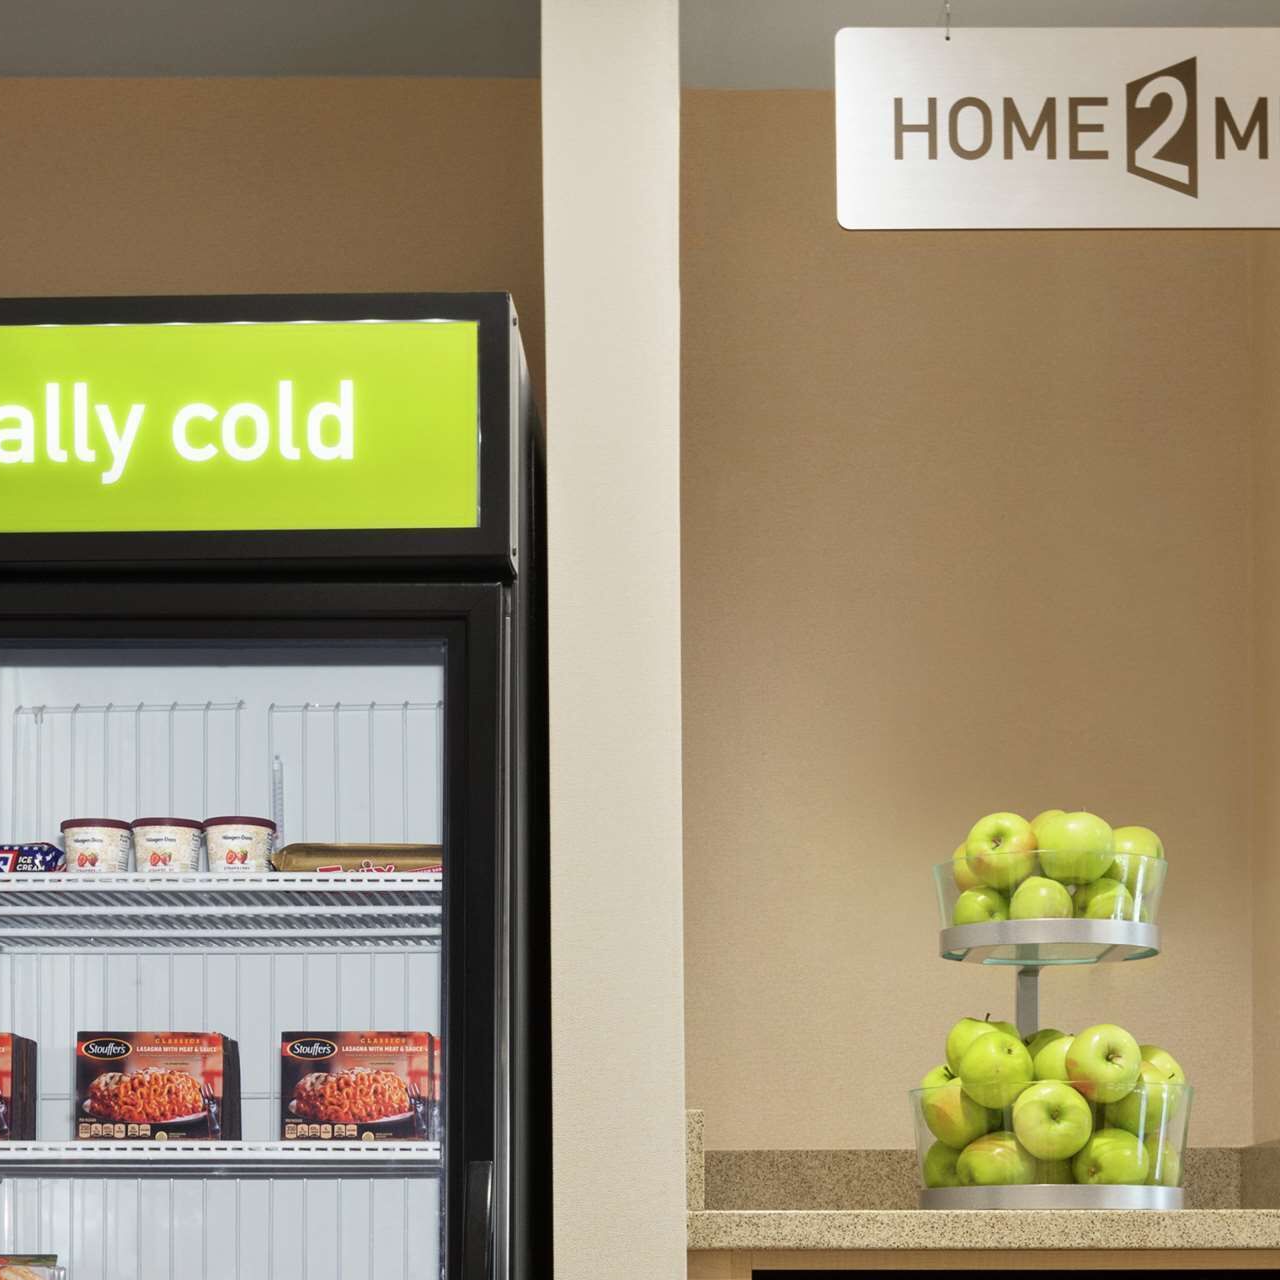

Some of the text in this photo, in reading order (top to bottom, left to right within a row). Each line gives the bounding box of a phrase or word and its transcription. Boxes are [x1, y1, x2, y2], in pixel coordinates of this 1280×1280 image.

[893, 96, 1109, 161] HOME
[171, 379, 354, 462] cold
[88, 1043, 126, 1056] Stouffer's
[293, 1043, 331, 1057] Stouffer's
